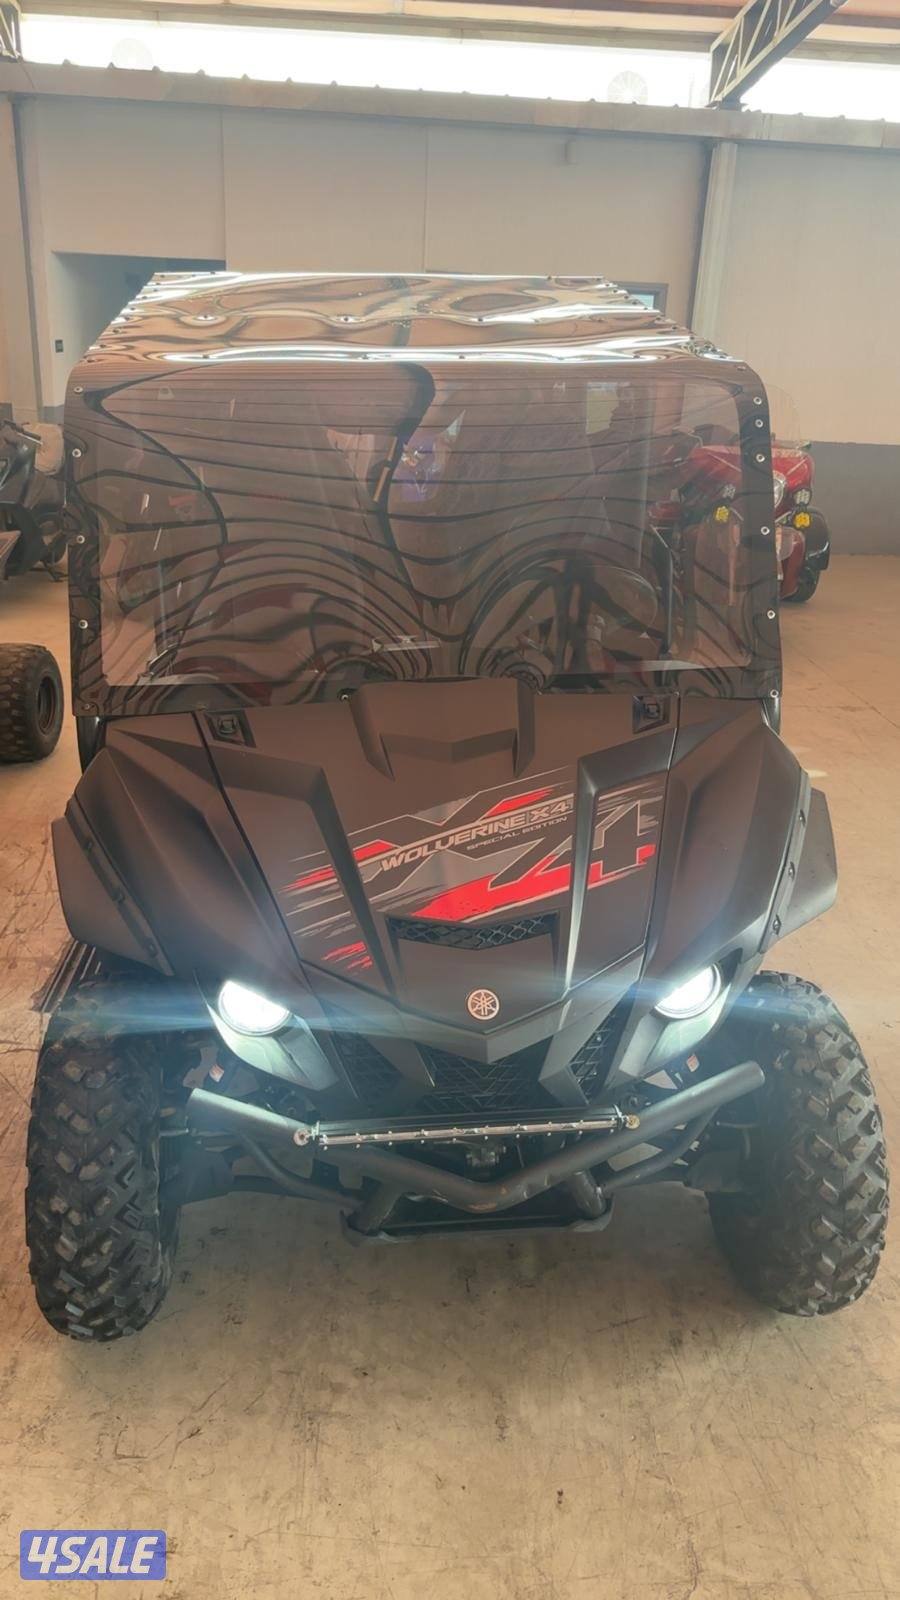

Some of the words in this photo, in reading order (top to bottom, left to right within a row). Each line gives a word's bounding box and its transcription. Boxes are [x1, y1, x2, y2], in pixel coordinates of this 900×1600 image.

[380, 815, 526, 871] WOLVERINE
[466, 830, 521, 851] SPECIAL
[521, 816, 568, 834] EDITION
